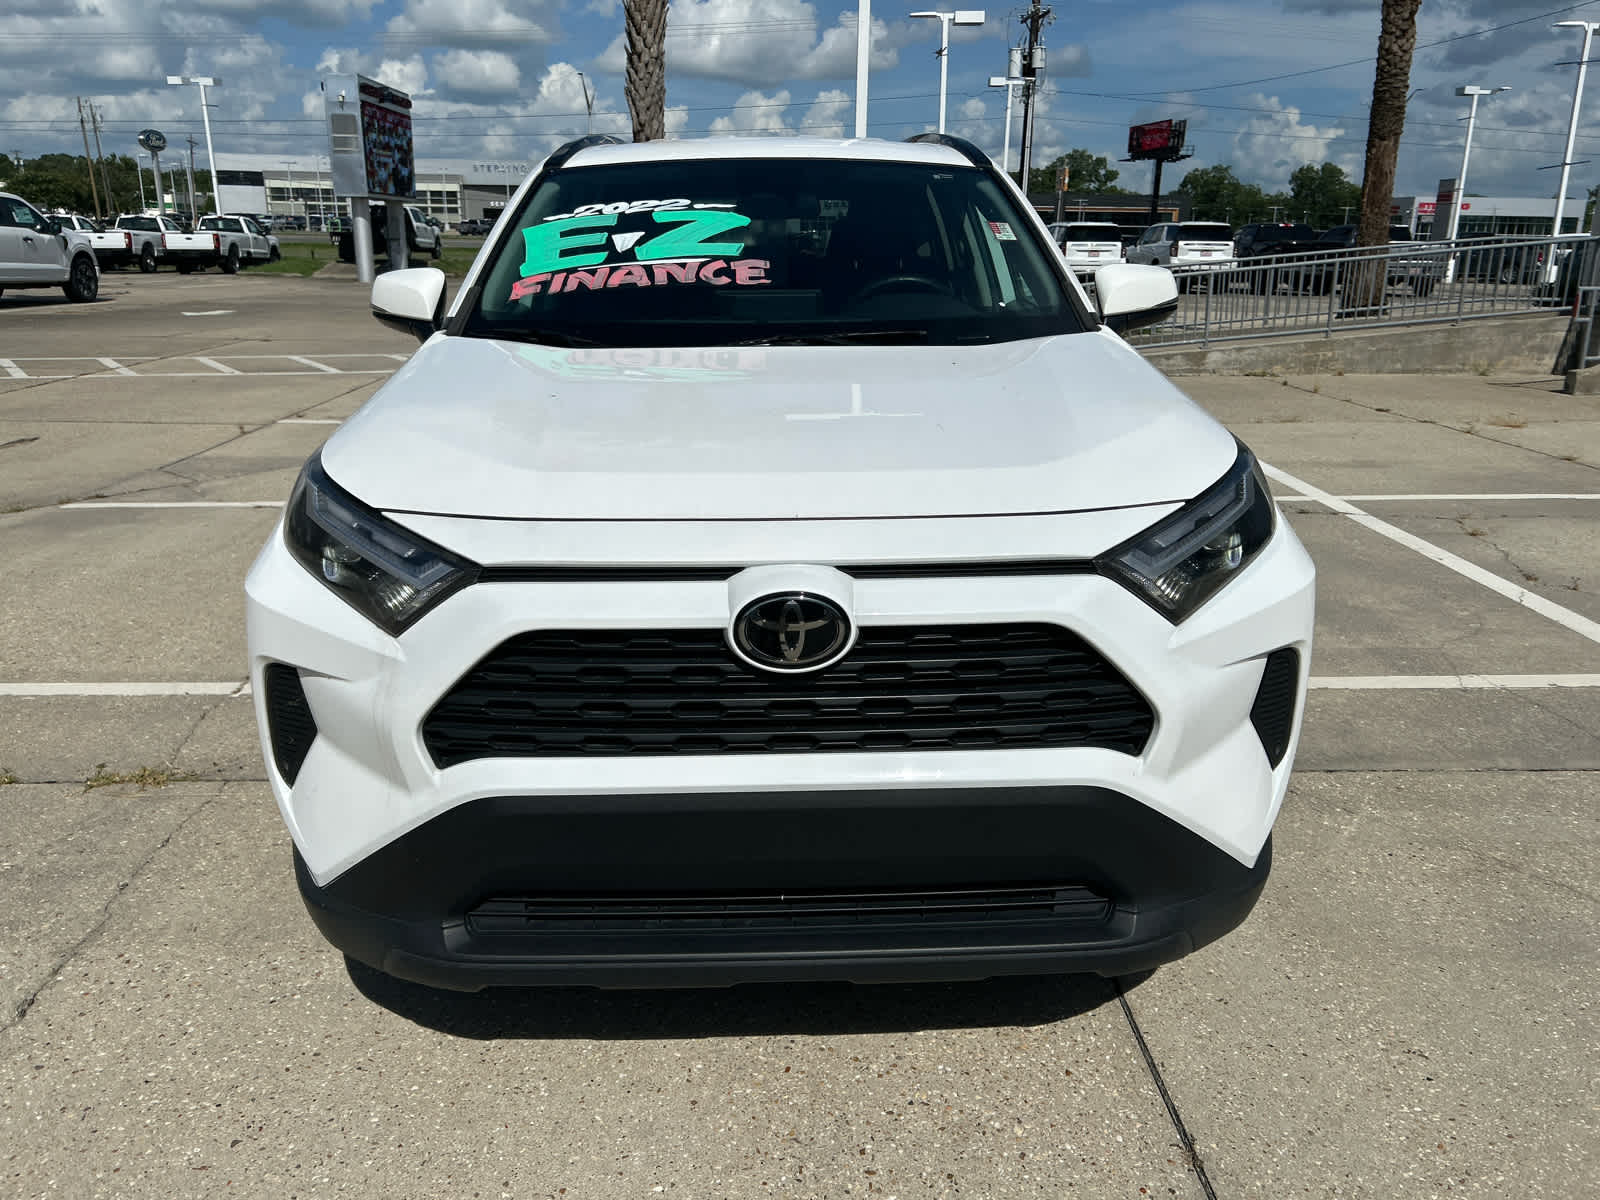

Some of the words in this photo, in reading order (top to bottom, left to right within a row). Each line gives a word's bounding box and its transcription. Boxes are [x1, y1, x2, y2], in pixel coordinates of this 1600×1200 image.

[473, 163, 529, 176] STERLING
[573, 199, 691, 217] 2022
[508, 259, 772, 302] FINANCE
